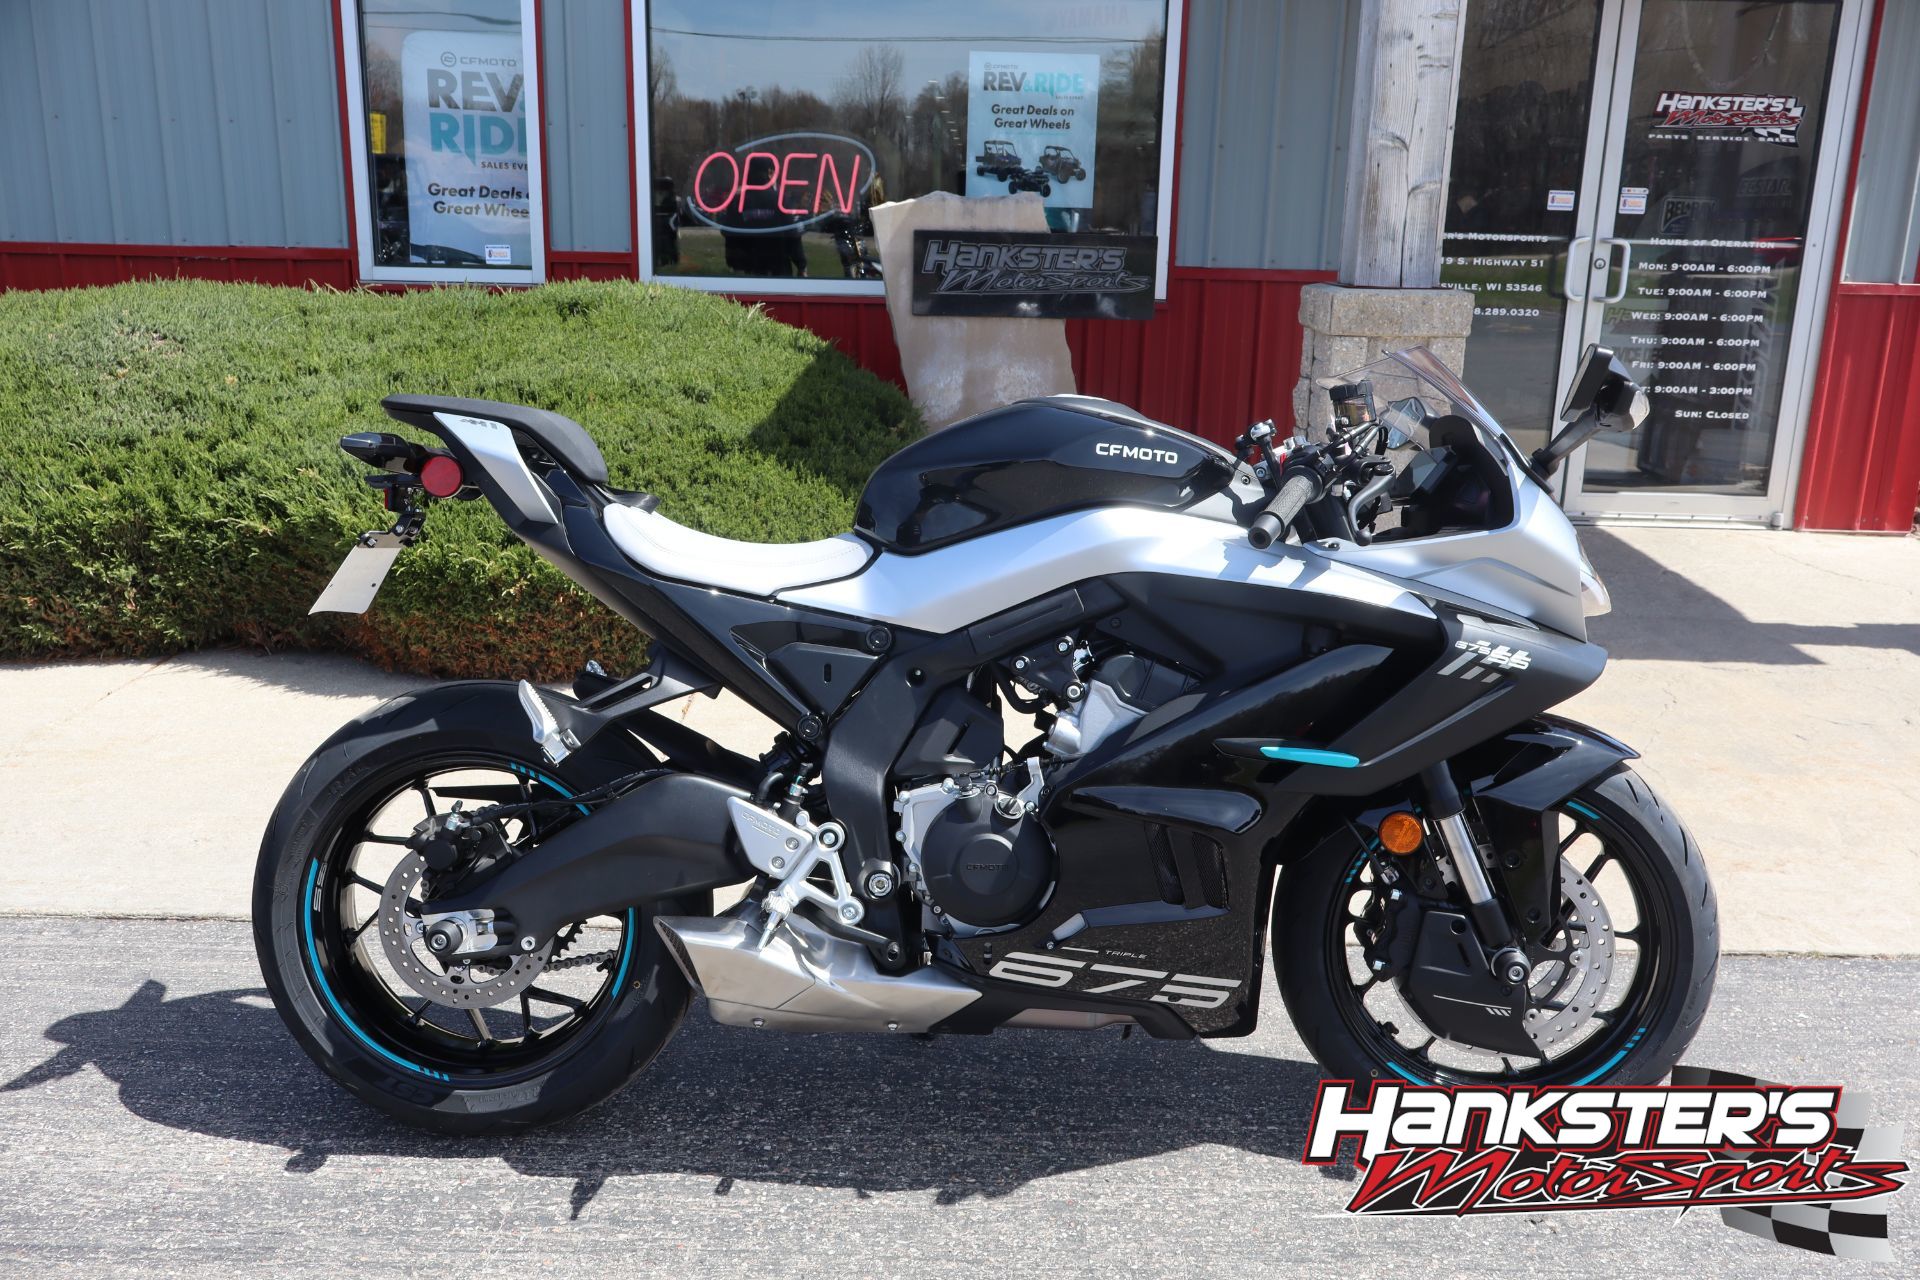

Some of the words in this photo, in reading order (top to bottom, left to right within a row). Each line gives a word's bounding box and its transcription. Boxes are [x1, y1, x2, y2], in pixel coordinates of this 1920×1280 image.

[460, 56, 517, 66] CFMOTO
[427, 68, 525, 112] REV
[991, 104, 1024, 115] Great
[1027, 104, 1057, 116] Deals
[1060, 108, 1074, 116] on
[994, 118, 1027, 129] Great
[1030, 118, 1070, 130] Wheels
[480, 161, 509, 170] SALES
[512, 162, 528, 172] EVE
[694, 151, 861, 214] OPEN
[428, 182, 475, 197] Great
[479, 185, 522, 200] Deals
[433, 201, 481, 215] Great
[484, 203, 530, 218] Whee
[1650, 238, 1688, 246] HOURS
[1692, 239, 1706, 247] OF
[1711, 239, 1775, 249] OPERATION
[1457, 257, 1469, 265] S.
[1473, 258, 1526, 267] HIGHWAY
[1531, 259, 1544, 267] 51
[1638, 262, 1667, 271] MON:
[1727, 265, 1771, 273] 6:00PM
[1486, 283, 1502, 291] WI
[1506, 284, 1543, 292] 53546
[1638, 287, 1664, 295] TUE:
[1667, 288, 1711, 296] 9:00AM
[1723, 290, 1767, 298] 6:00PM
[1473, 308, 1540, 317] 8.289.0320
[1631, 312, 1660, 320] WED:
[1664, 312, 1708, 321] 9:00AM
[1720, 314, 1763, 322] 6:00PM
[1631, 337, 1657, 345] THU:
[1661, 337, 1705, 345] 9:00AM
[1716, 339, 1760, 347] 6:00PM
[1631, 361, 1654, 369] FRI:
[1658, 361, 1701, 370] 9:00AM
[1713, 363, 1756, 371] 6:00PM
[1654, 386, 1698, 394] 9:00AM
[1709, 387, 1752, 395] 3:00PM
[1675, 410, 1702, 418] SUN:
[1706, 411, 1750, 420] CLOSED
[1095, 442, 1178, 464] CFMOTO
[1104, 949, 1148, 960] TRIPLE
[989, 951, 1242, 1009] 675
